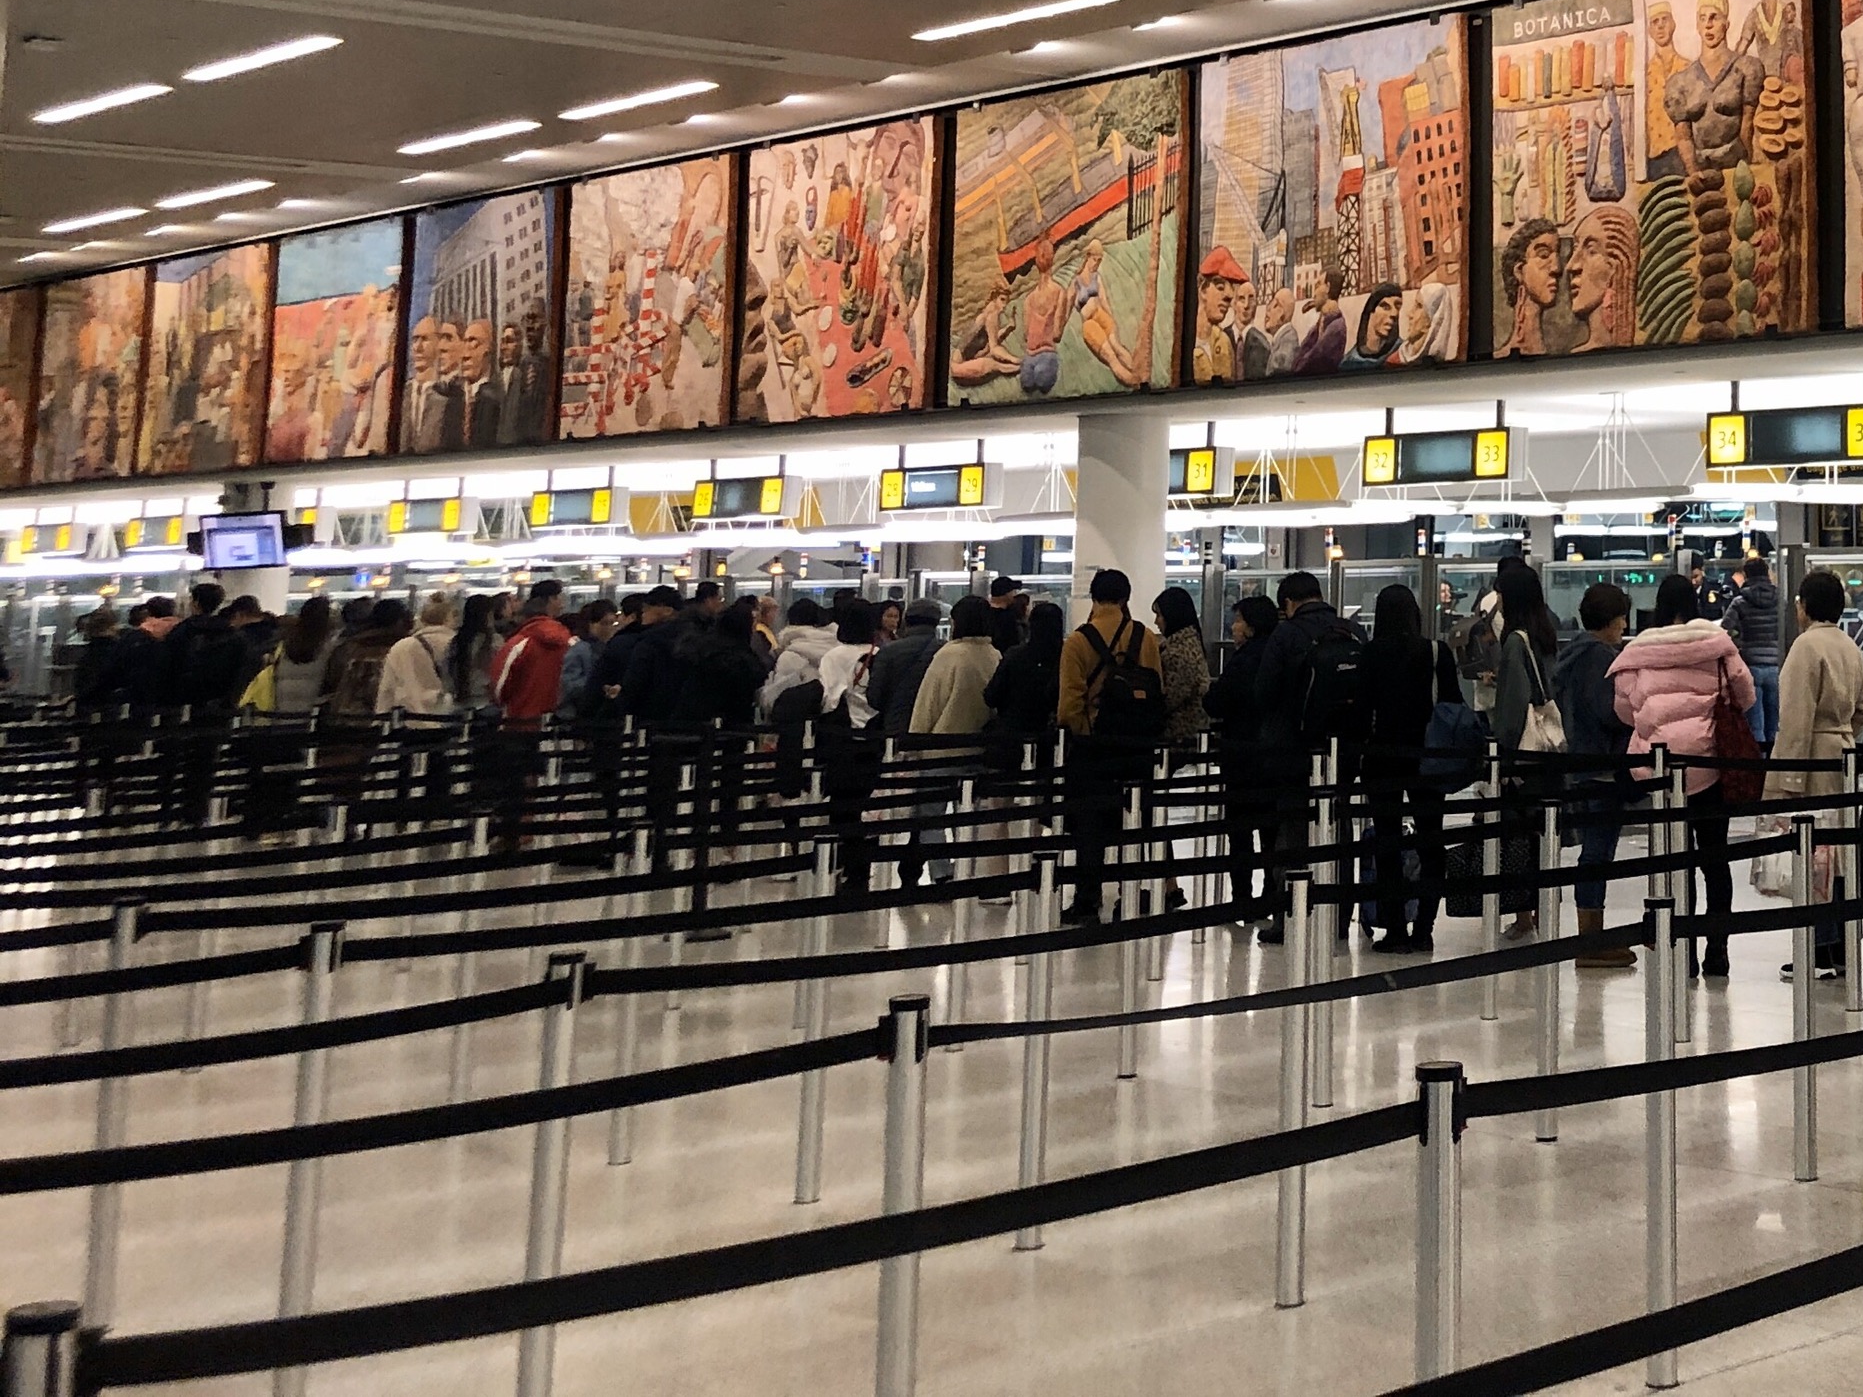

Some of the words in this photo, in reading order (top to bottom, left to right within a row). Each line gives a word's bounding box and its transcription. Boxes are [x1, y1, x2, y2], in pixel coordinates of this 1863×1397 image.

[1514, 6, 1611, 39] BOTANICA
[1718, 430, 1736, 450] 34
[1373, 452, 1388, 469] 32
[1484, 444, 1500, 463] 33
[1194, 462, 1208, 479] 31
